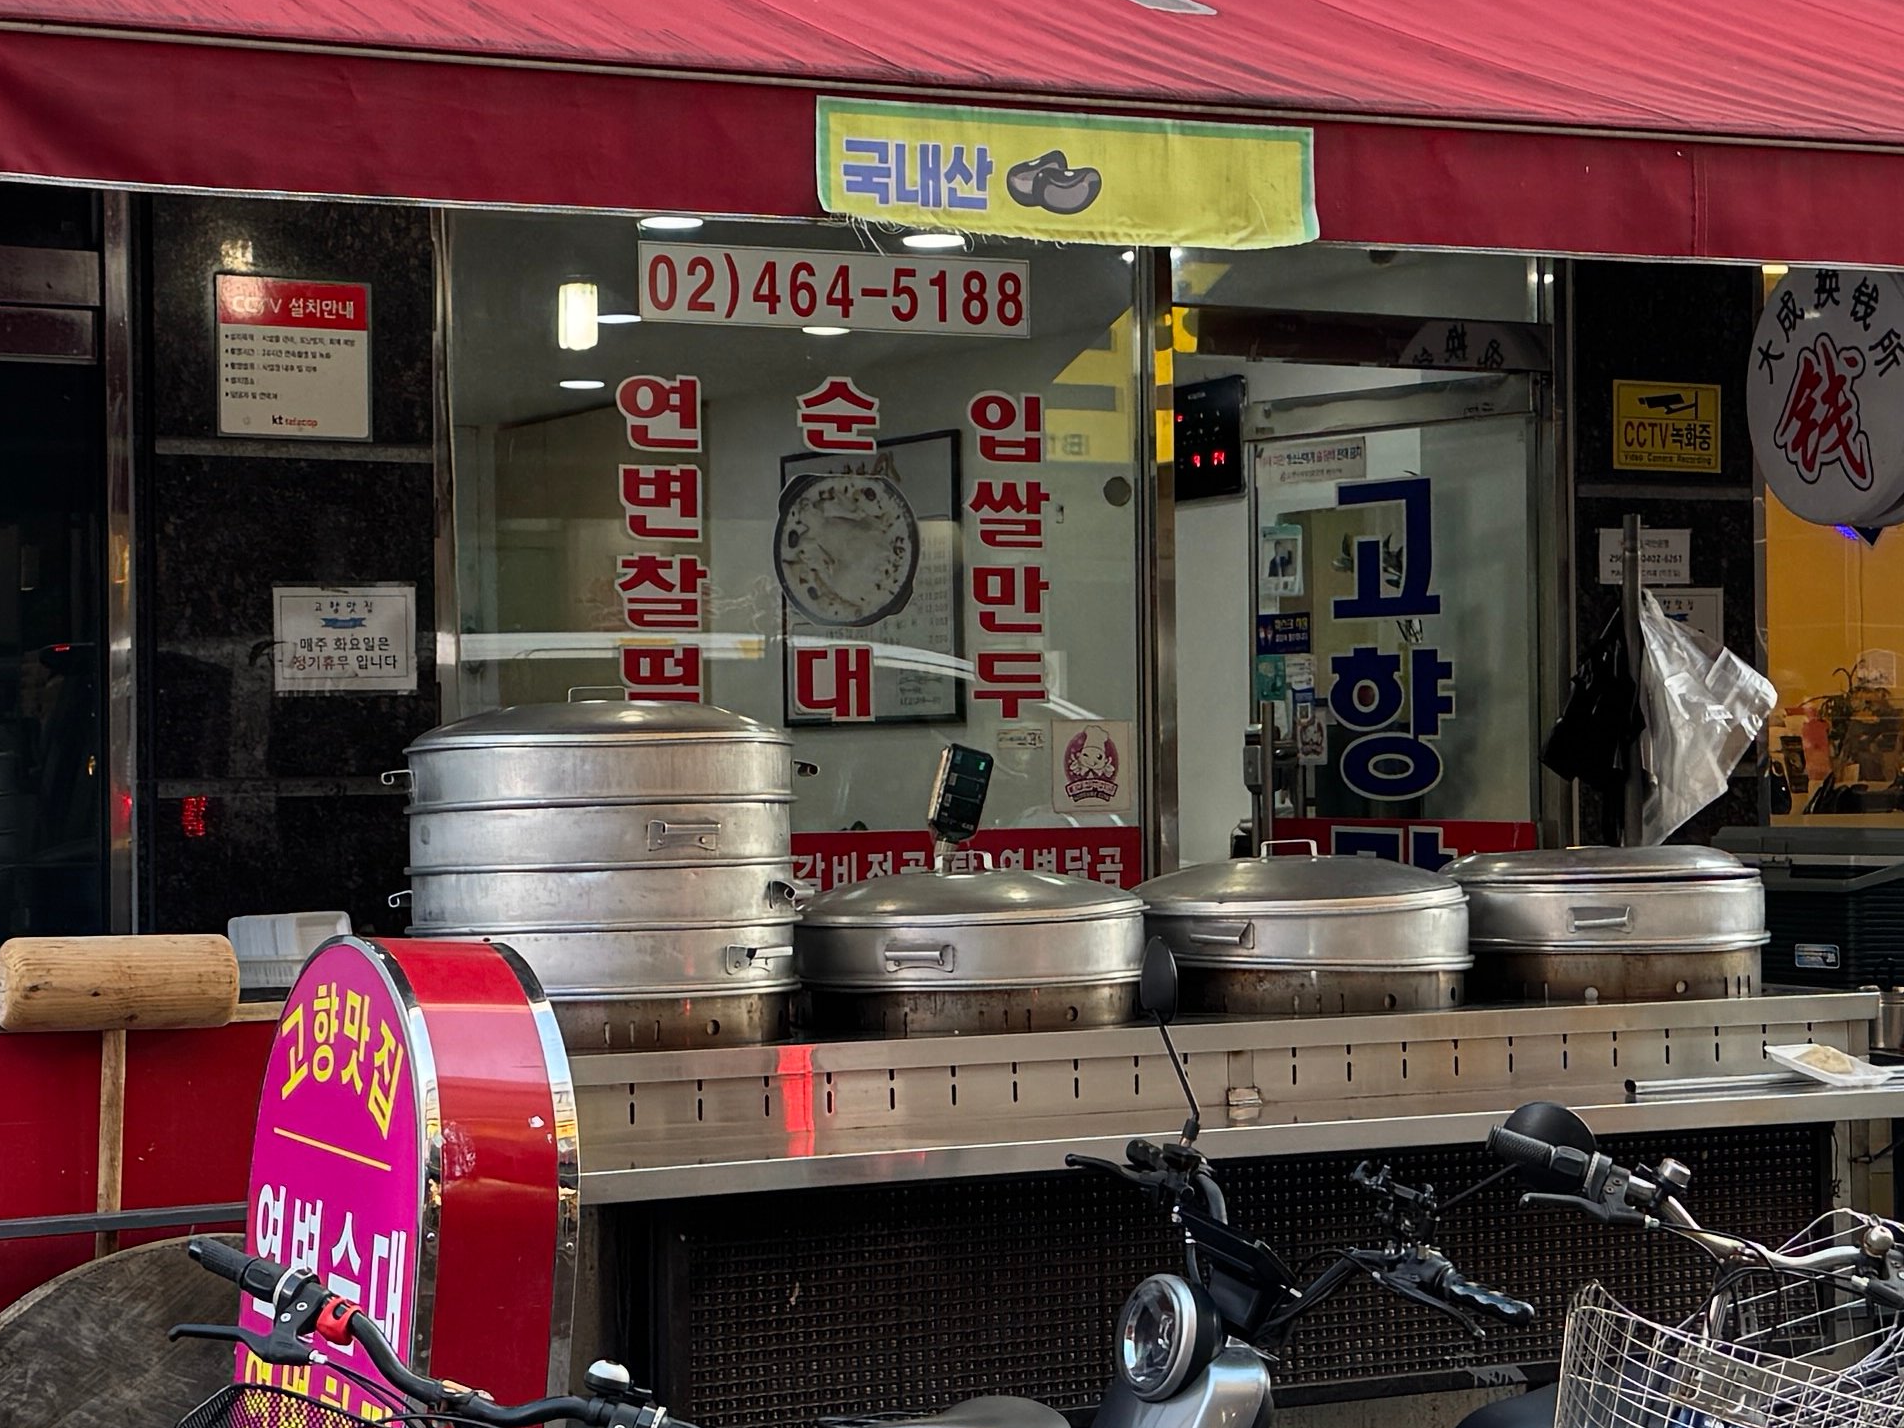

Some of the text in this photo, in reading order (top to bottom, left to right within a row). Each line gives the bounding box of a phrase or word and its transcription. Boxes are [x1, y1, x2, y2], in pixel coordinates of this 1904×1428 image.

[841, 137, 994, 211] 국내산
[289, 298, 355, 320] 설치안내
[646, 250, 1026, 328] 02)464-5188
[1624, 420, 1712, 451] CCTV녹화중
[969, 393, 1049, 719] 입쌀만두
[299, 637, 328, 652] 매주
[356, 654, 398, 670] 입니다
[281, 981, 405, 1140] 고향맛집
